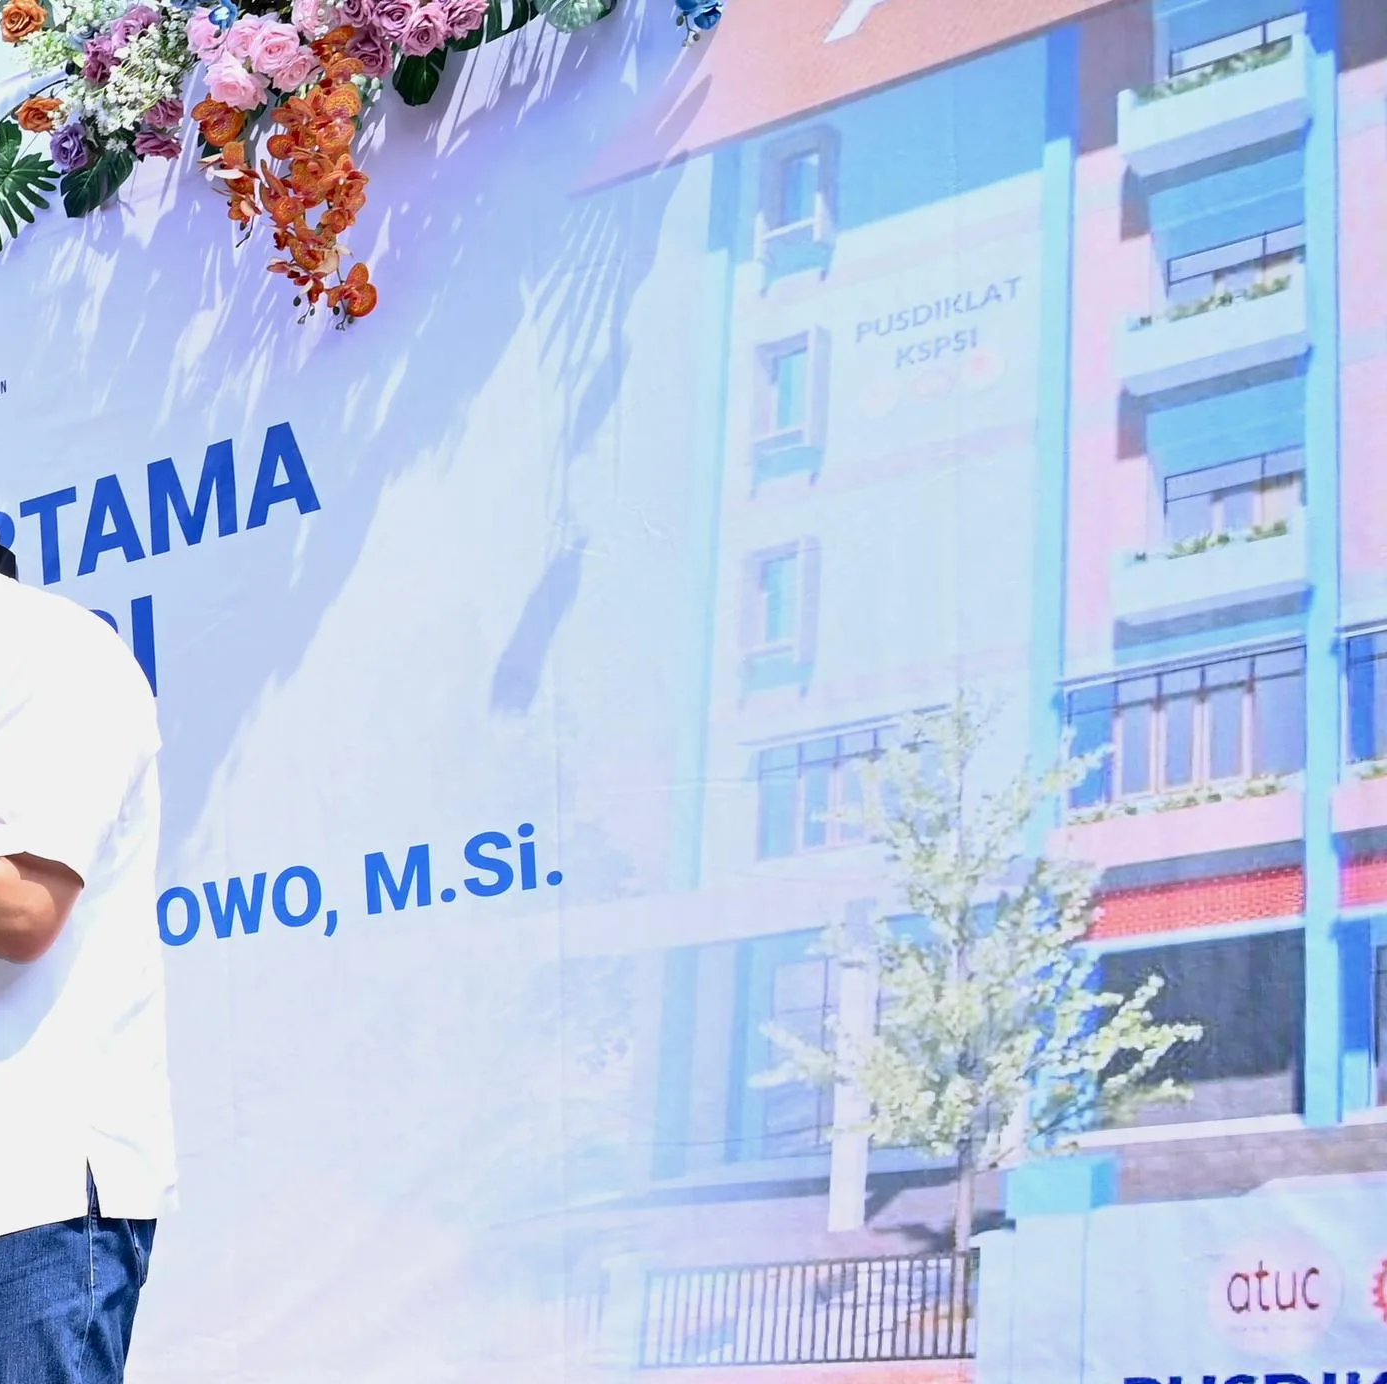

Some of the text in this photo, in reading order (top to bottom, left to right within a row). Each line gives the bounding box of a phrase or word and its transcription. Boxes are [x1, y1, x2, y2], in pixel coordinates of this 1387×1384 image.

[855, 276, 1022, 343] PUSDIKLAT
[895, 327, 978, 369] KSPSI
[156, 864, 339, 947] OWO,
[364, 822, 564, 916] M.Si.
[1227, 1260, 1320, 1314] atuc
